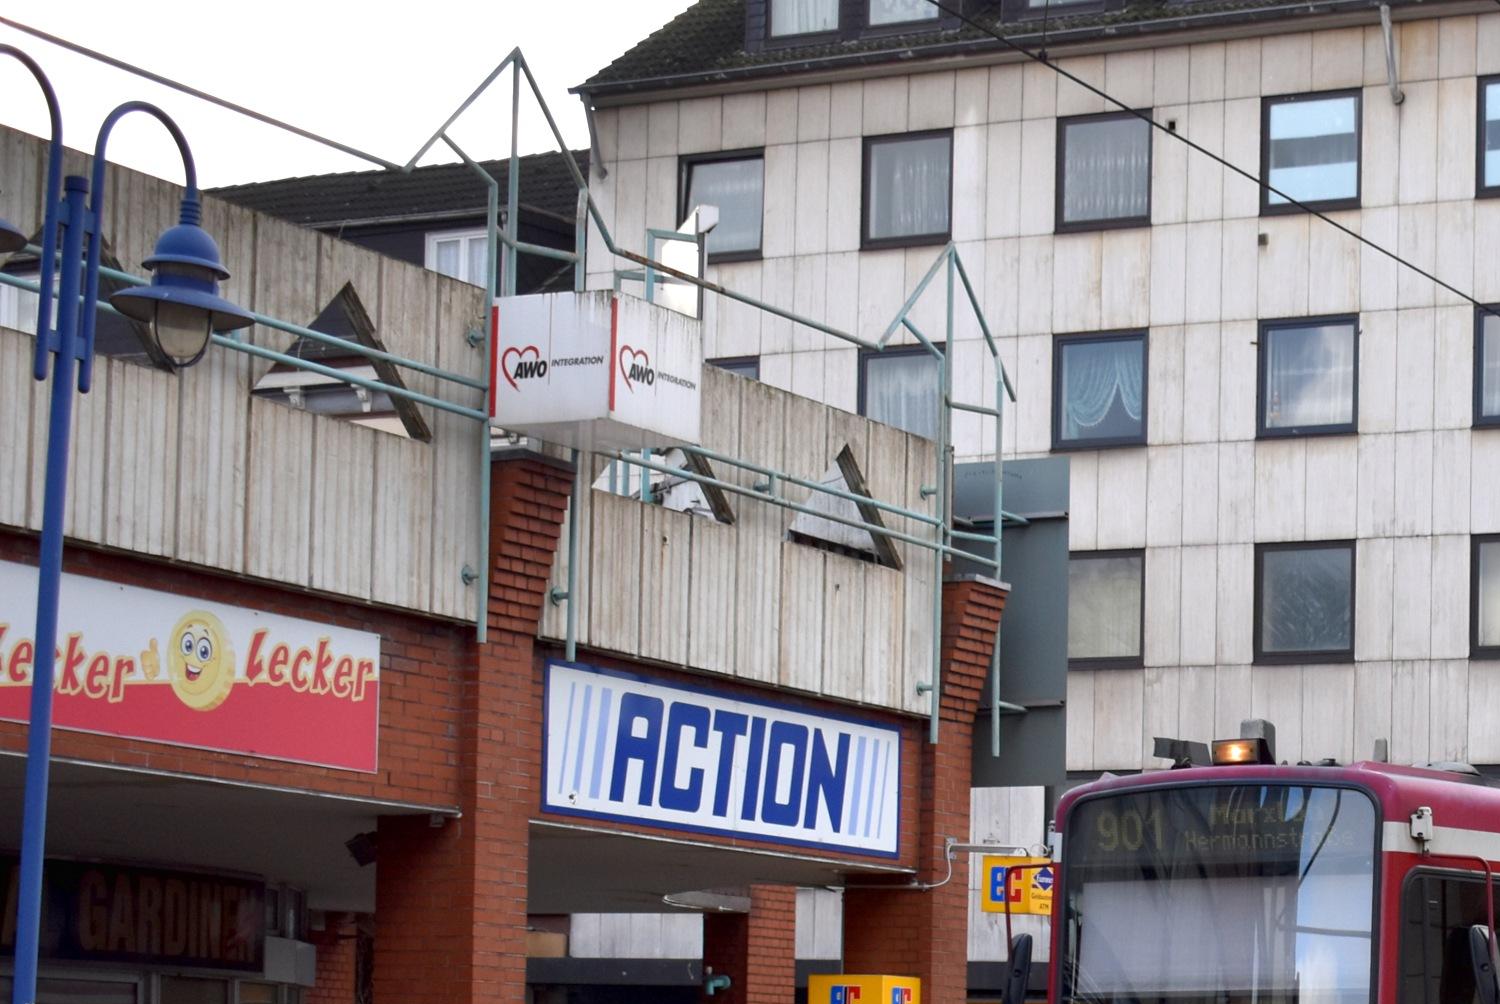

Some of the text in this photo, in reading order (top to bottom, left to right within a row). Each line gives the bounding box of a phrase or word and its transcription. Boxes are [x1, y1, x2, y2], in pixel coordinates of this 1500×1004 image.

[513, 355, 604, 380] AWO INTEGRATION
[628, 363, 696, 391] AWO INTEGRATION
[0, 625, 134, 702] eker
[245, 629, 375, 701] Lecker
[609, 691, 851, 834] ACTION
[1098, 808, 1164, 852] 901
